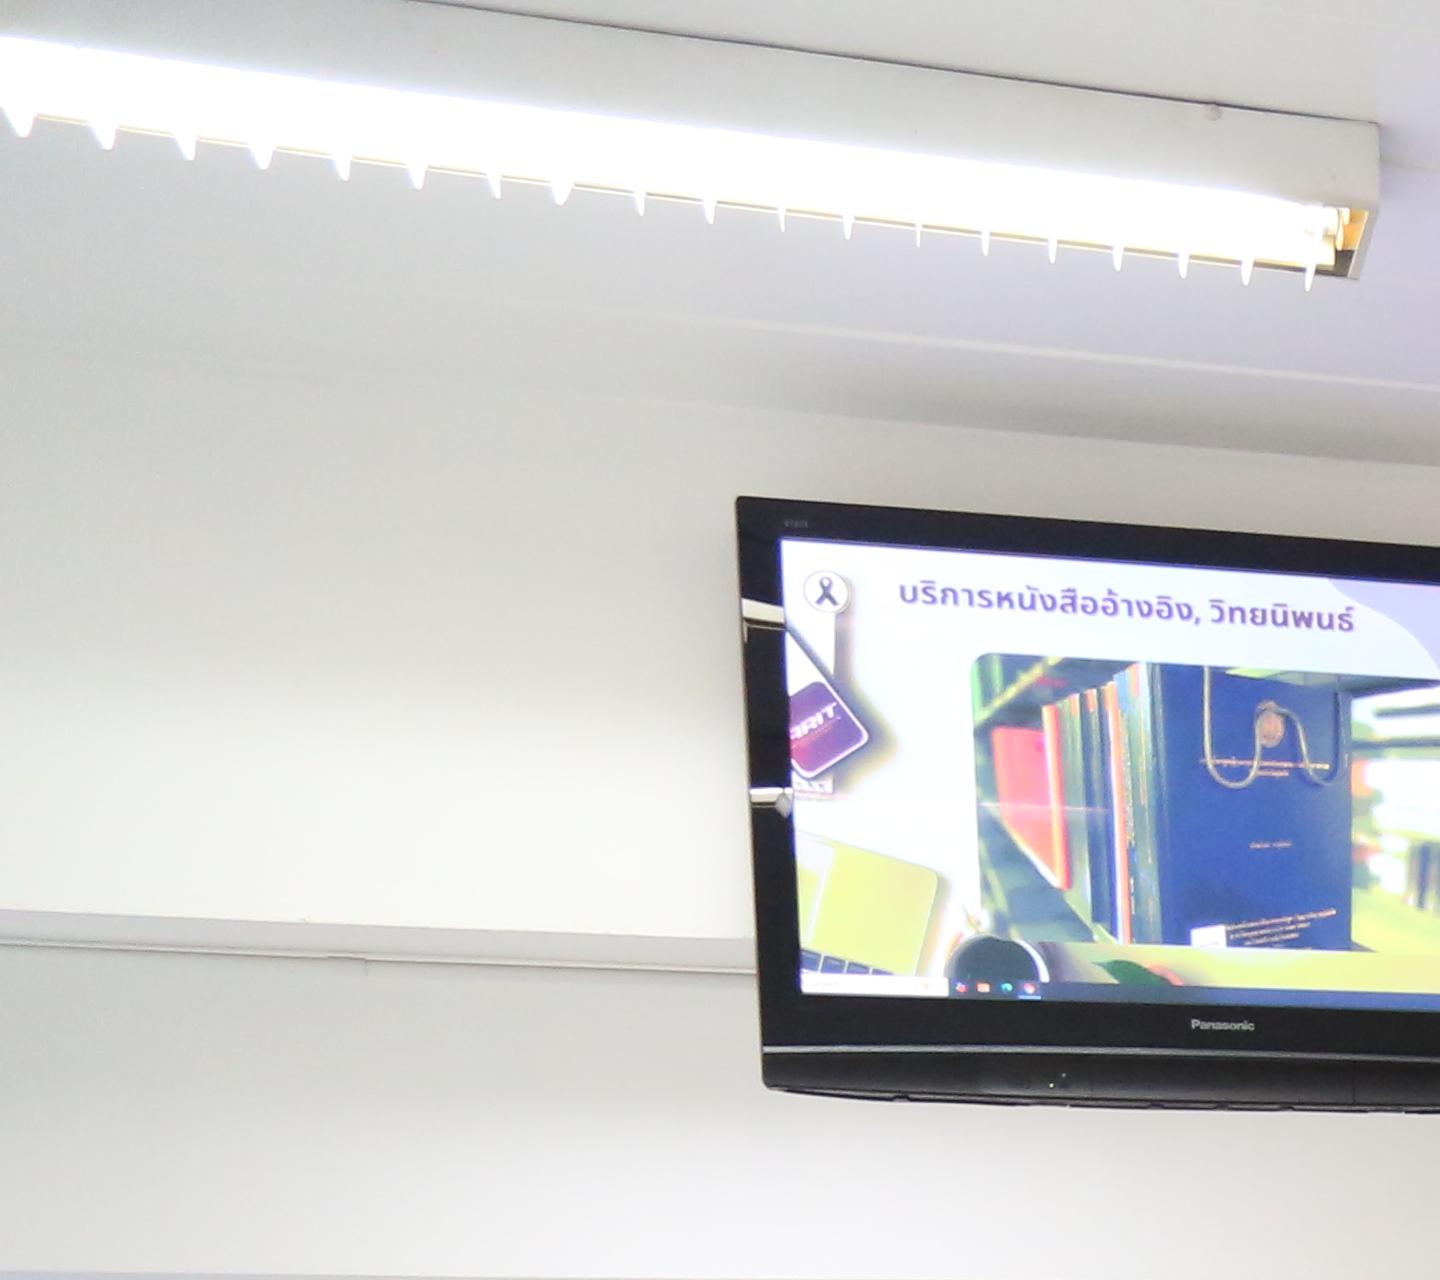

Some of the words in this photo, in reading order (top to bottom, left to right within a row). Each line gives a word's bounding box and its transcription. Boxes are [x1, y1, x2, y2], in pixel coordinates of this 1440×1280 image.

[898, 579, 1201, 626] บริการหนังสืออ้างอิง,
[1208, 598, 1355, 633] วิทยนิพนธ์
[1191, 1018, 1256, 1032] Panasonic
